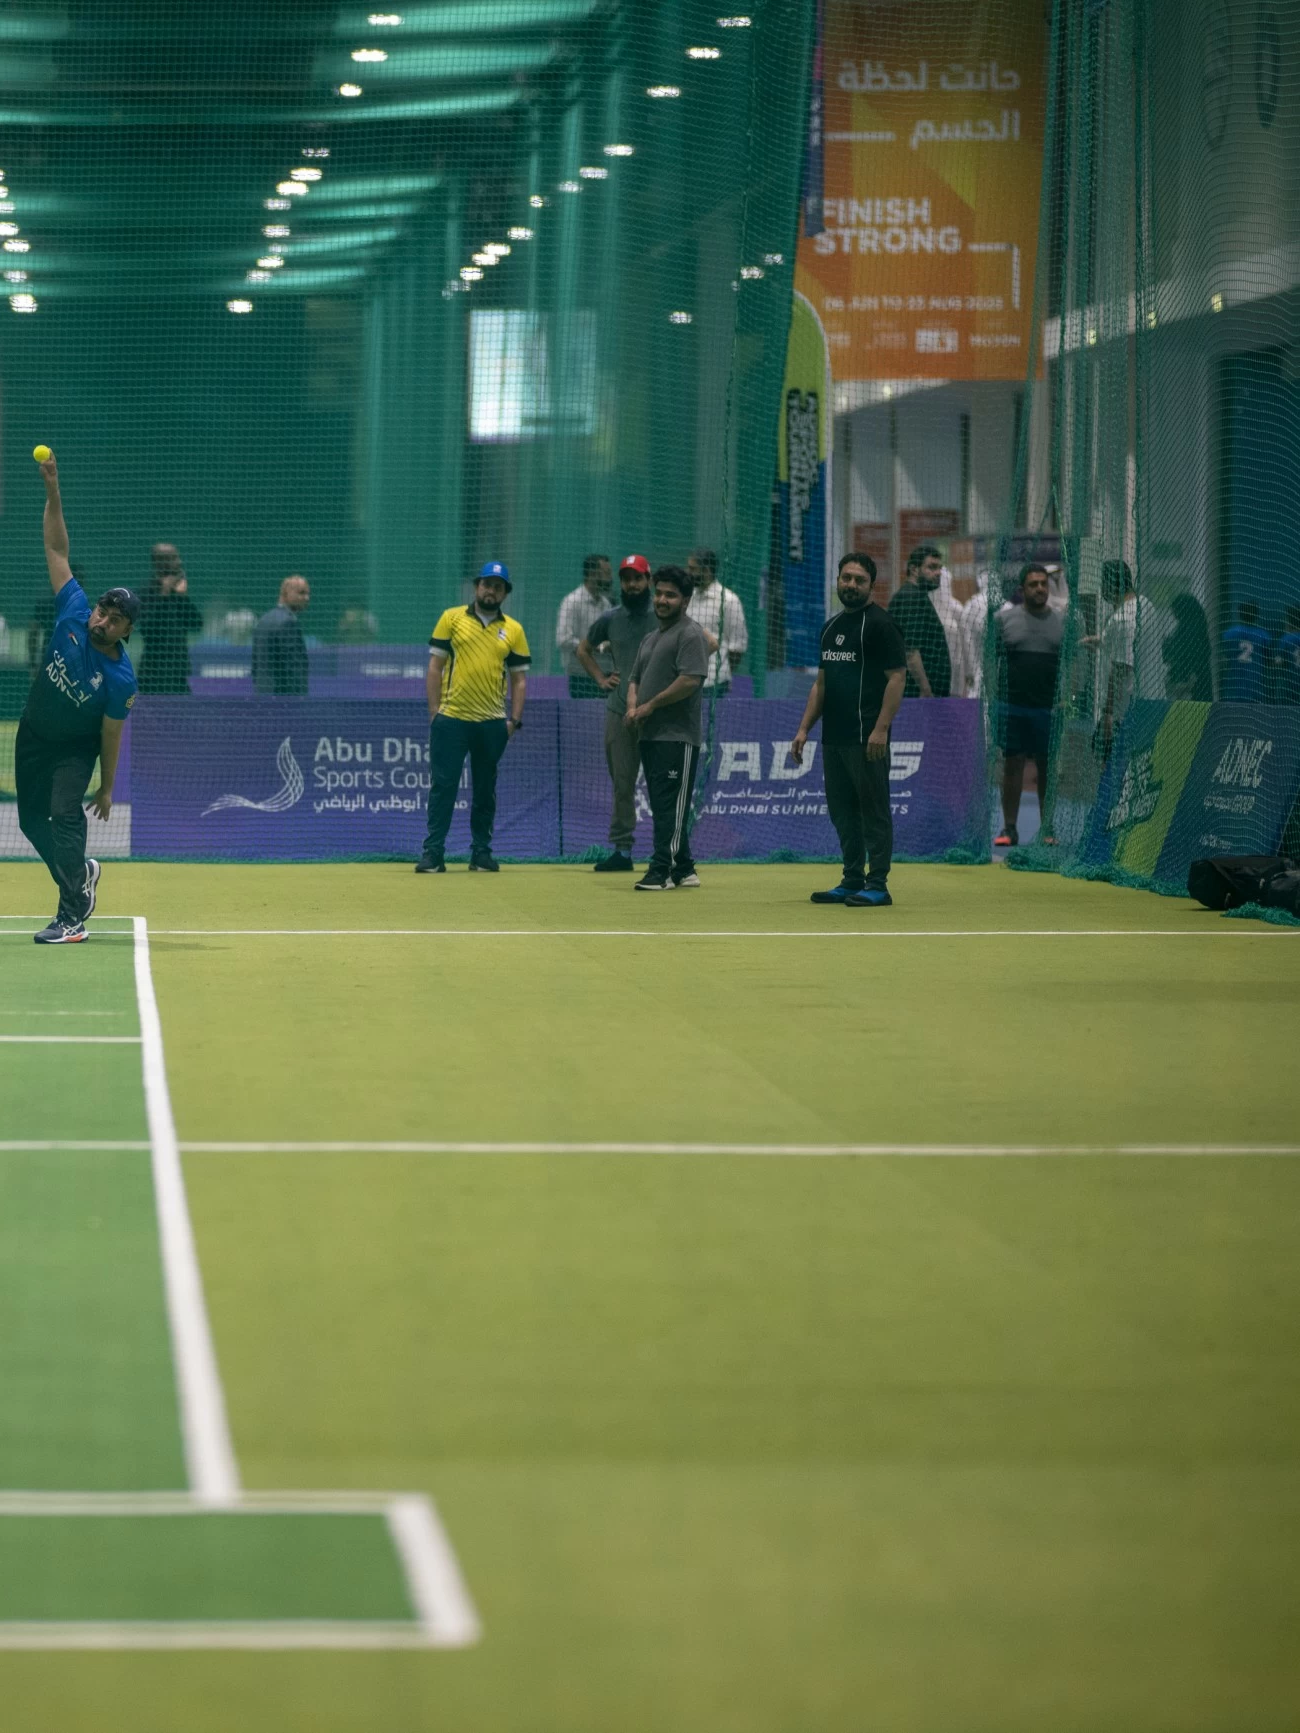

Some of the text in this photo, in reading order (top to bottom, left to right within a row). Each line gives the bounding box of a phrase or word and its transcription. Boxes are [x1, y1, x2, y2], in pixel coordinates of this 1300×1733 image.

[838, 60, 929, 92] لحظة
[909, 108, 1021, 150] الحسم
[823, 197, 931, 225] FINISH
[814, 226, 962, 254] STRONG
[1238, 641, 1254, 663] 2
[314, 737, 372, 763] Abu
[716, 741, 924, 781] ADS
[313, 766, 385, 792] Sports
[730, 804, 767, 815] DHABI
[771, 804, 828, 815] SUMME
